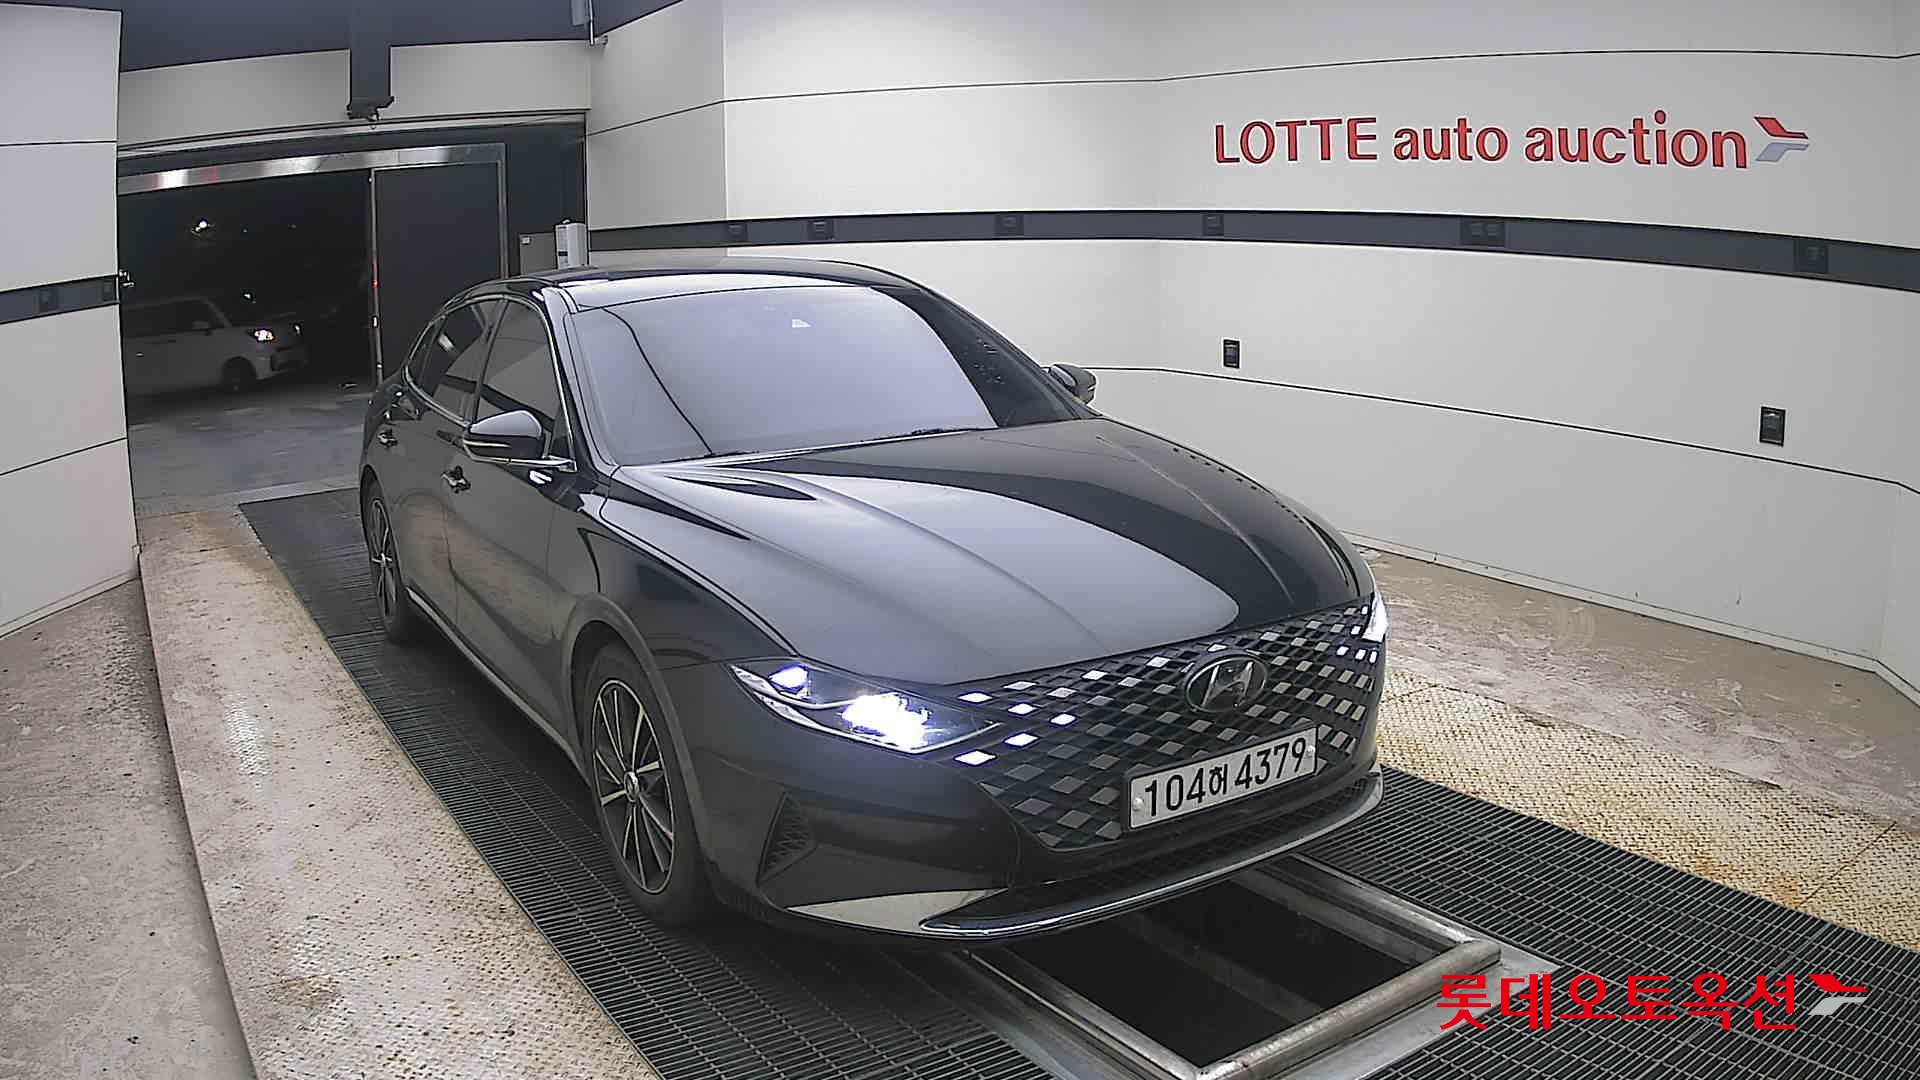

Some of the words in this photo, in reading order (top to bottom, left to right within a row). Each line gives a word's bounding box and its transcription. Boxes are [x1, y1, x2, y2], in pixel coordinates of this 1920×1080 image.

[1214, 117, 1378, 164] LOTTE
[1393, 117, 1509, 162] auto
[1524, 110, 1749, 169] auction
